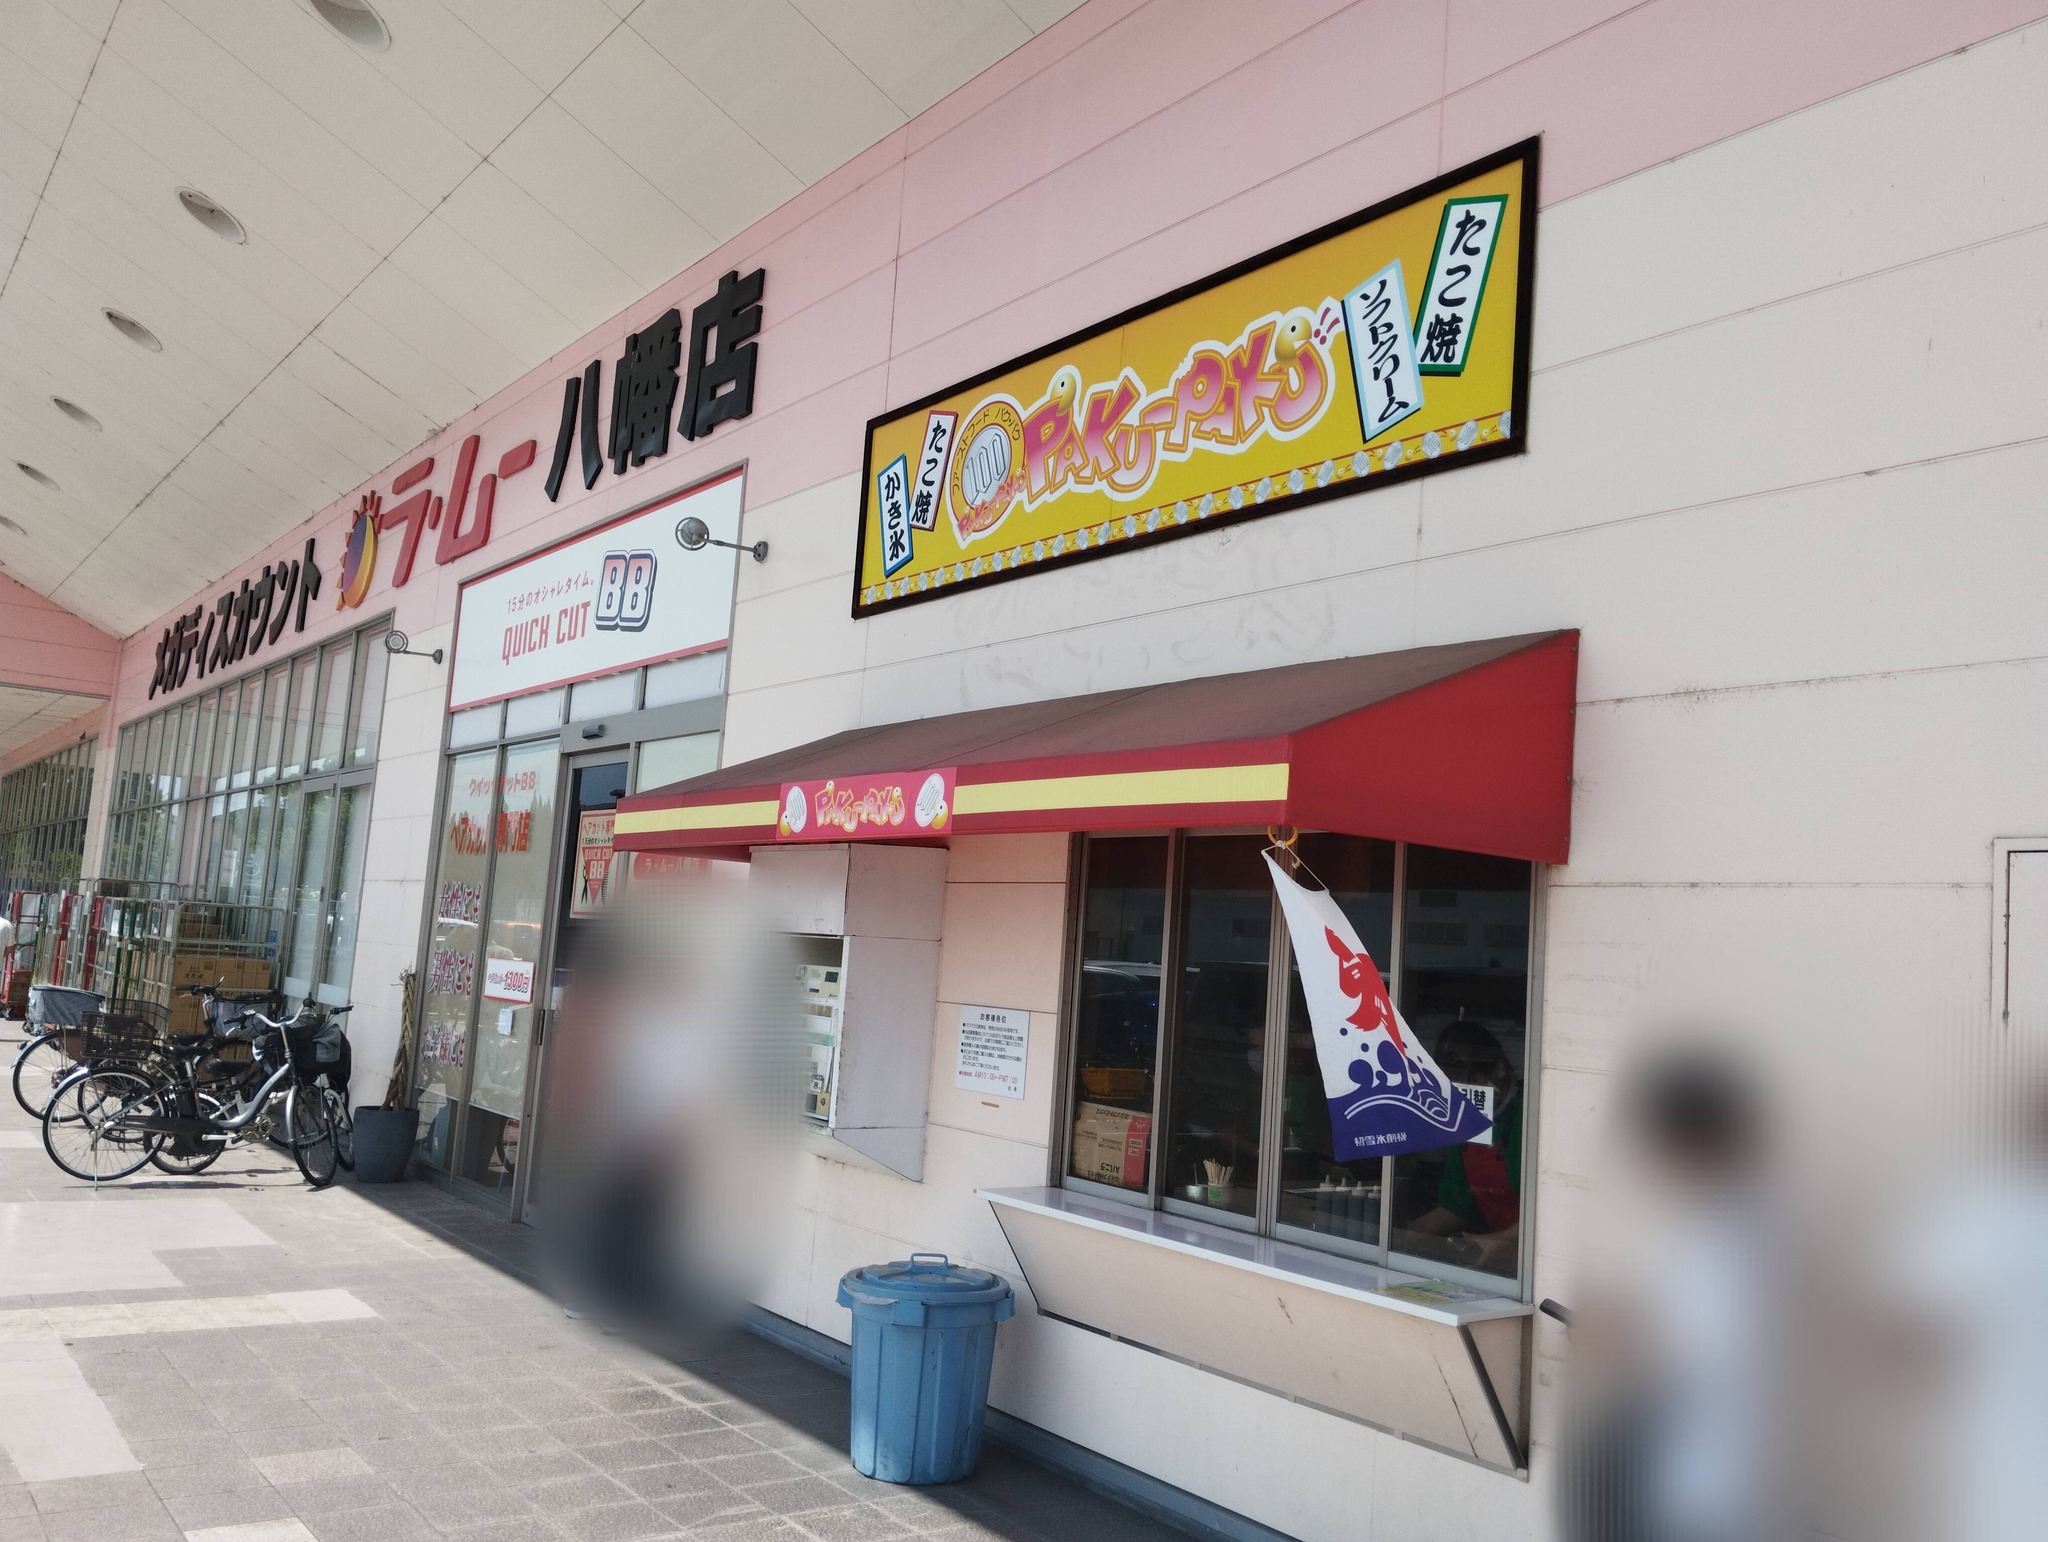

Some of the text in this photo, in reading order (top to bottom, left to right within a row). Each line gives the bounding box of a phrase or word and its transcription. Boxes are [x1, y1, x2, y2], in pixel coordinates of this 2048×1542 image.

[1420, 209, 1487, 363] たこ焼
[1360, 279, 1410, 423] ソフトクリーム
[148, 538, 322, 700] メガディスカウント
[544, 268, 765, 502] 八幡店
[911, 420, 947, 525] たこ焼
[952, 409, 990, 496] ファーストフード
[966, 432, 1006, 505] 100
[885, 471, 906, 562] かき氷
[502, 549, 658, 666] QUICK CUT BB
[507, 571, 594, 614] 15分のオシャレタイム。
[815, 785, 906, 833] PAKU-PAKU
[588, 860, 605, 879] BB
[428, 949, 475, 999] 男性にも
[504, 970, 531, 993] 1300円
